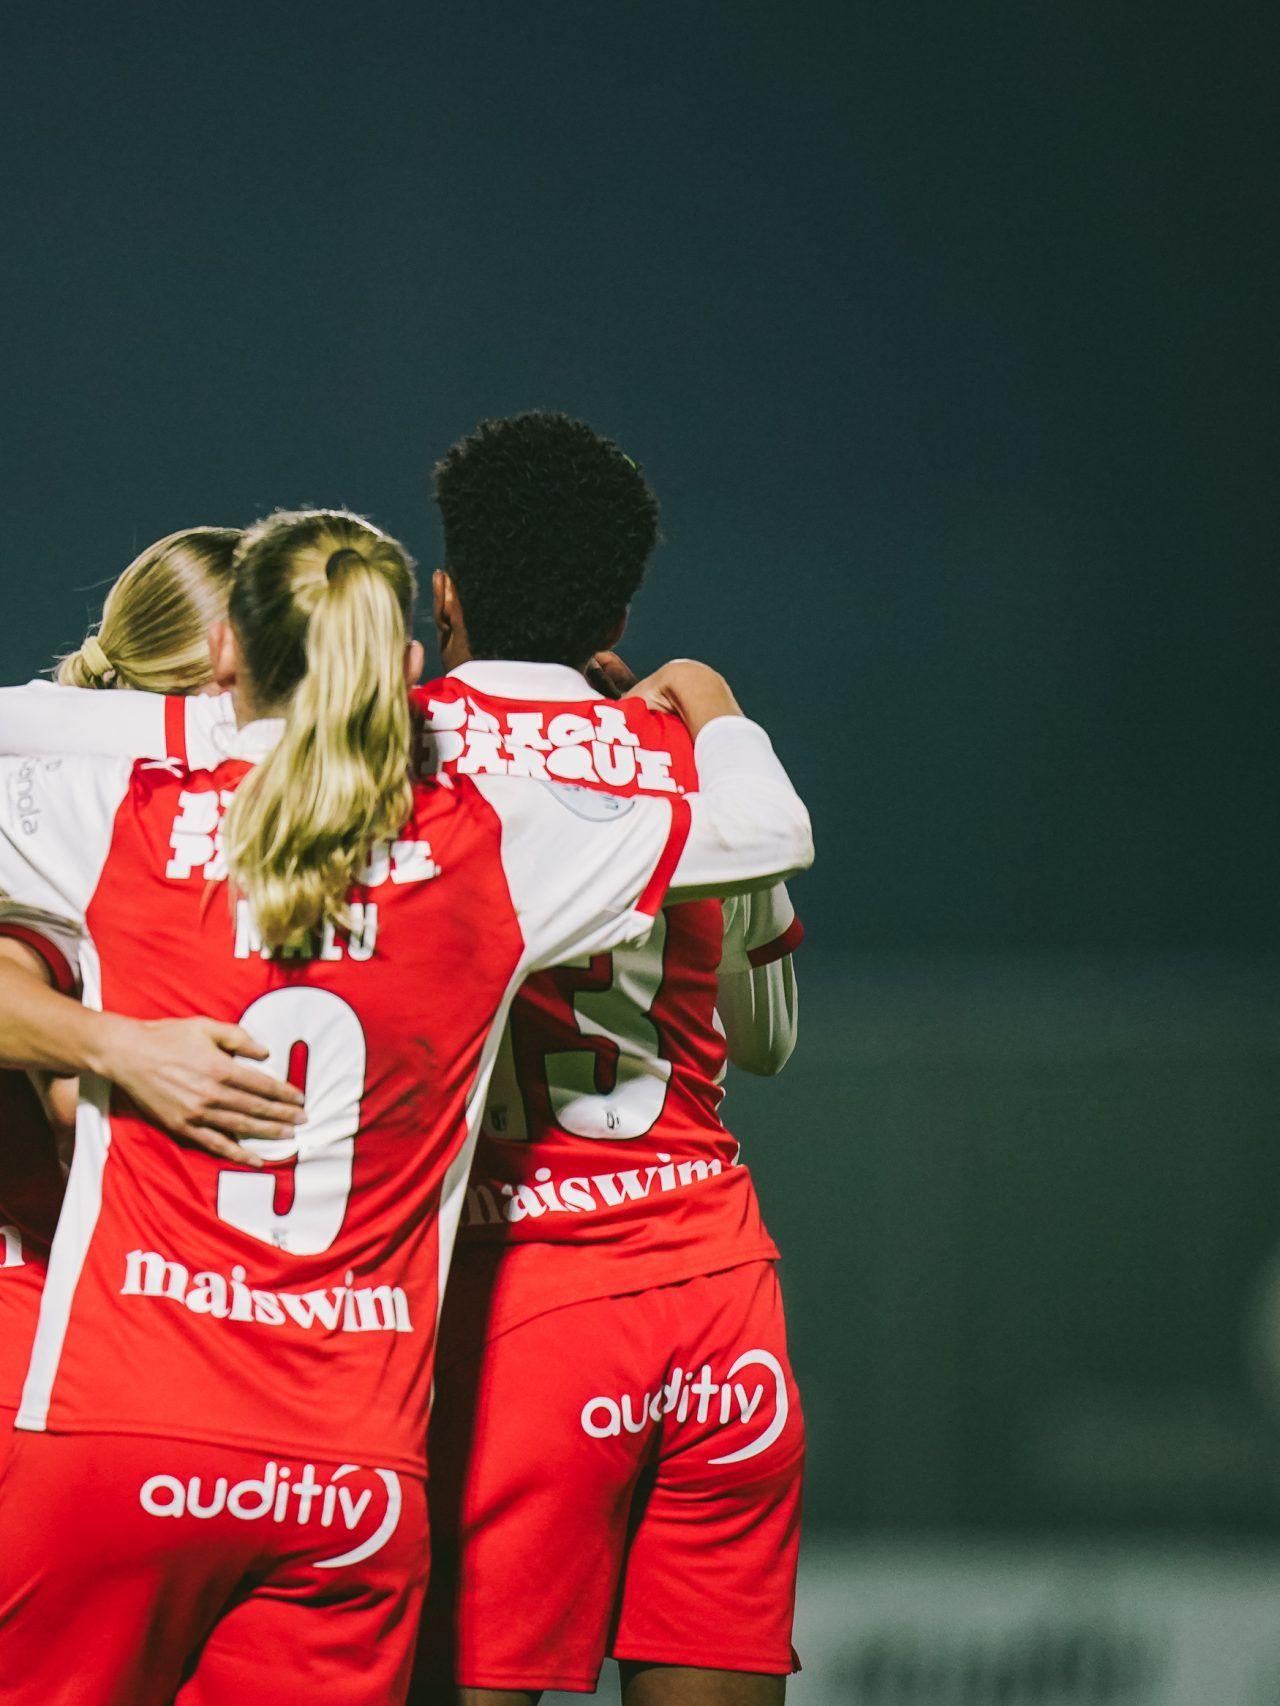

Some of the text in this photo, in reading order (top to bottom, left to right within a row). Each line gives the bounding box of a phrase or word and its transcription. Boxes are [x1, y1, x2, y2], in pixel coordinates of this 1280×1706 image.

[217, 985, 368, 1256] 9
[120, 1249, 414, 1333] maiswim
[580, 1363, 765, 1439] auditiv
[139, 1460, 373, 1531] auditiv
